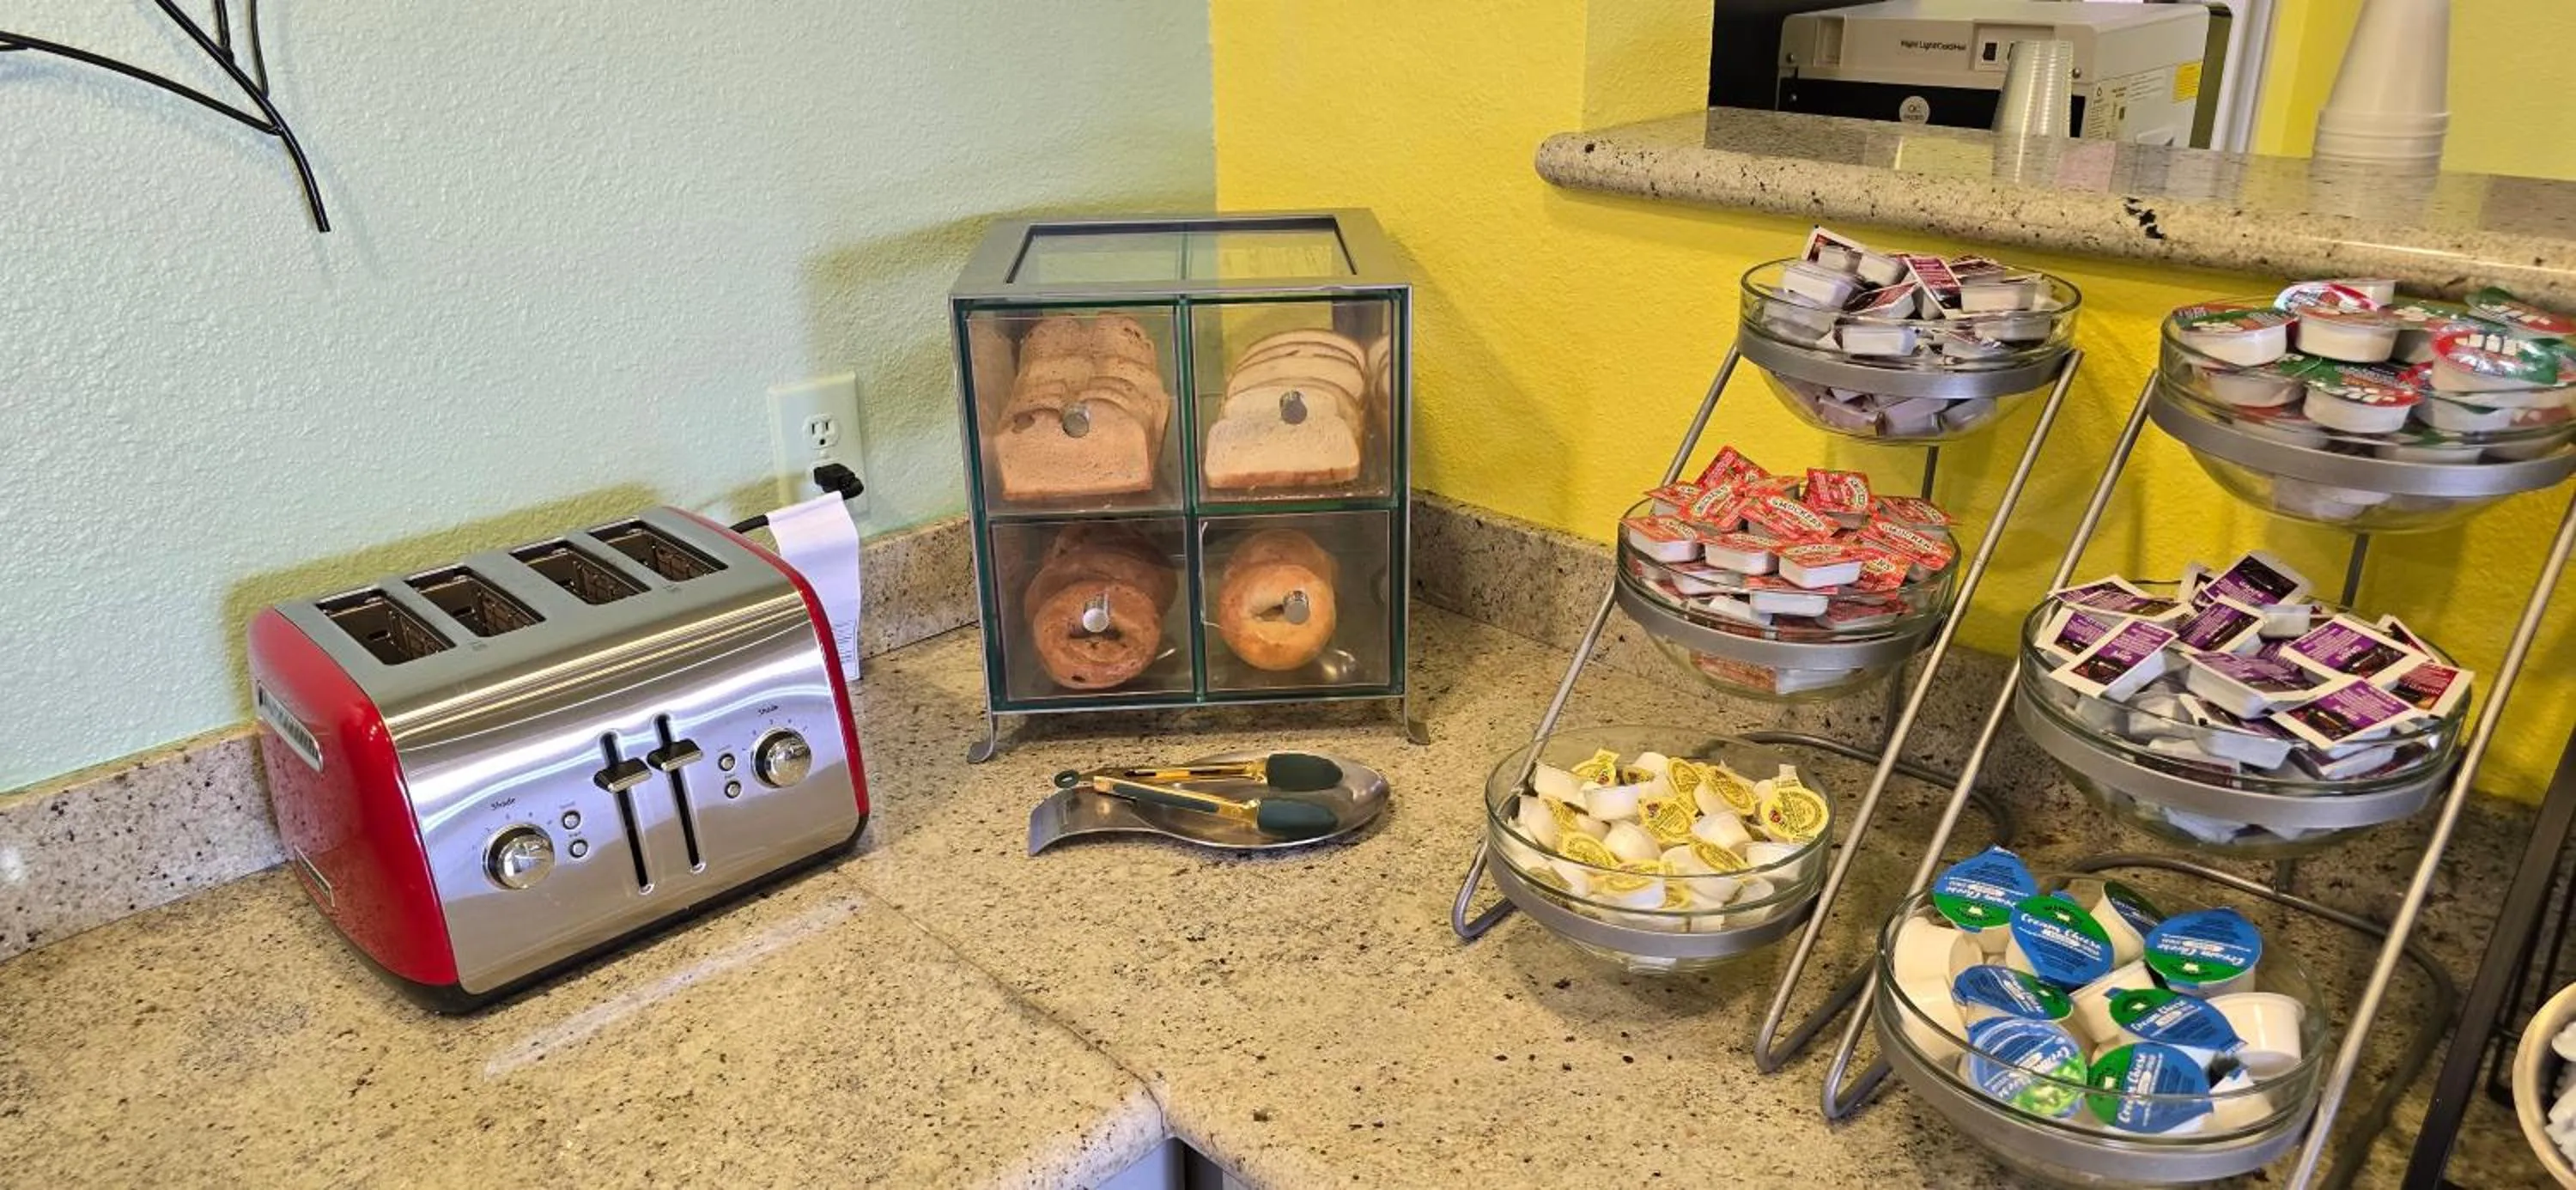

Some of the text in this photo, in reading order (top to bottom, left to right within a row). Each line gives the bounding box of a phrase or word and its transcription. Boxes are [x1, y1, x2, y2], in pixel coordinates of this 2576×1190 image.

[2020, 913, 2102, 950] Cream Cheese
[2129, 999, 2188, 1032] Cream Cheese
[2125, 1052, 2147, 1084] Cheese
